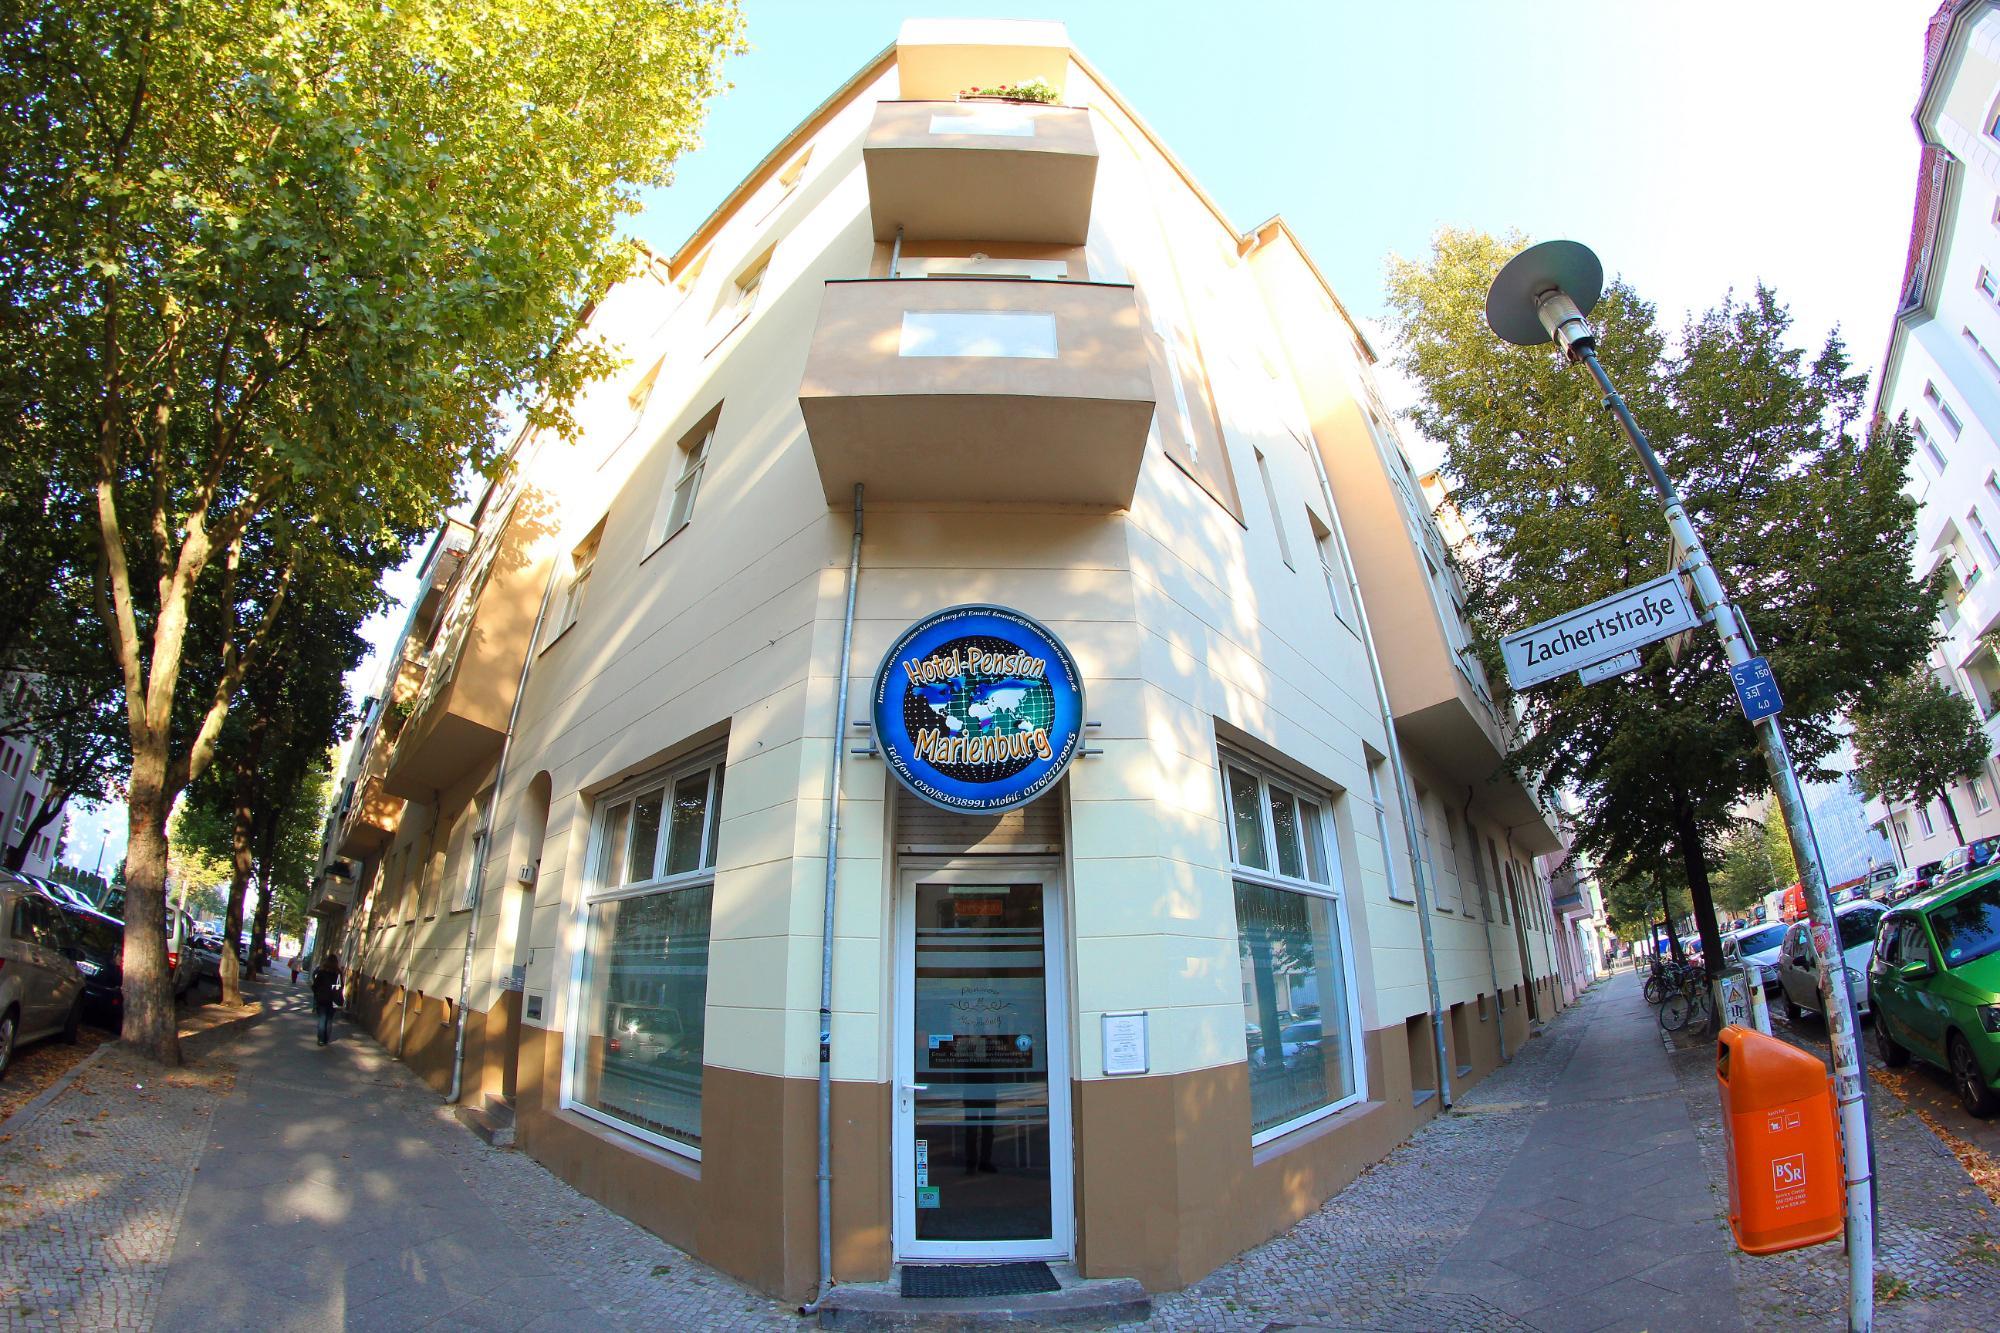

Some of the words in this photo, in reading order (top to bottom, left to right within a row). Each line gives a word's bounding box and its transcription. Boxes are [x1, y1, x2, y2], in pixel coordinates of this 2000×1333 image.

[1520, 596, 1675, 667] Zachertstraße
[902, 646, 1046, 686] Hotel-Pension
[1598, 665, 1605, 674] 5
[1613, 659, 1622, 668] 11
[1734, 672, 1746, 686] S
[1754, 668, 1769, 680] 150
[914, 727, 1053, 765] Marienburg
[887, 743, 914, 781] Telefon:
[914, 779, 986, 808] 030/83038991
[988, 791, 1021, 808] Mobil:
[1023, 732, 1076, 796] 0176/27279945
[521, 868, 529, 878] 11
[1776, 1163, 1802, 1183] BSR
